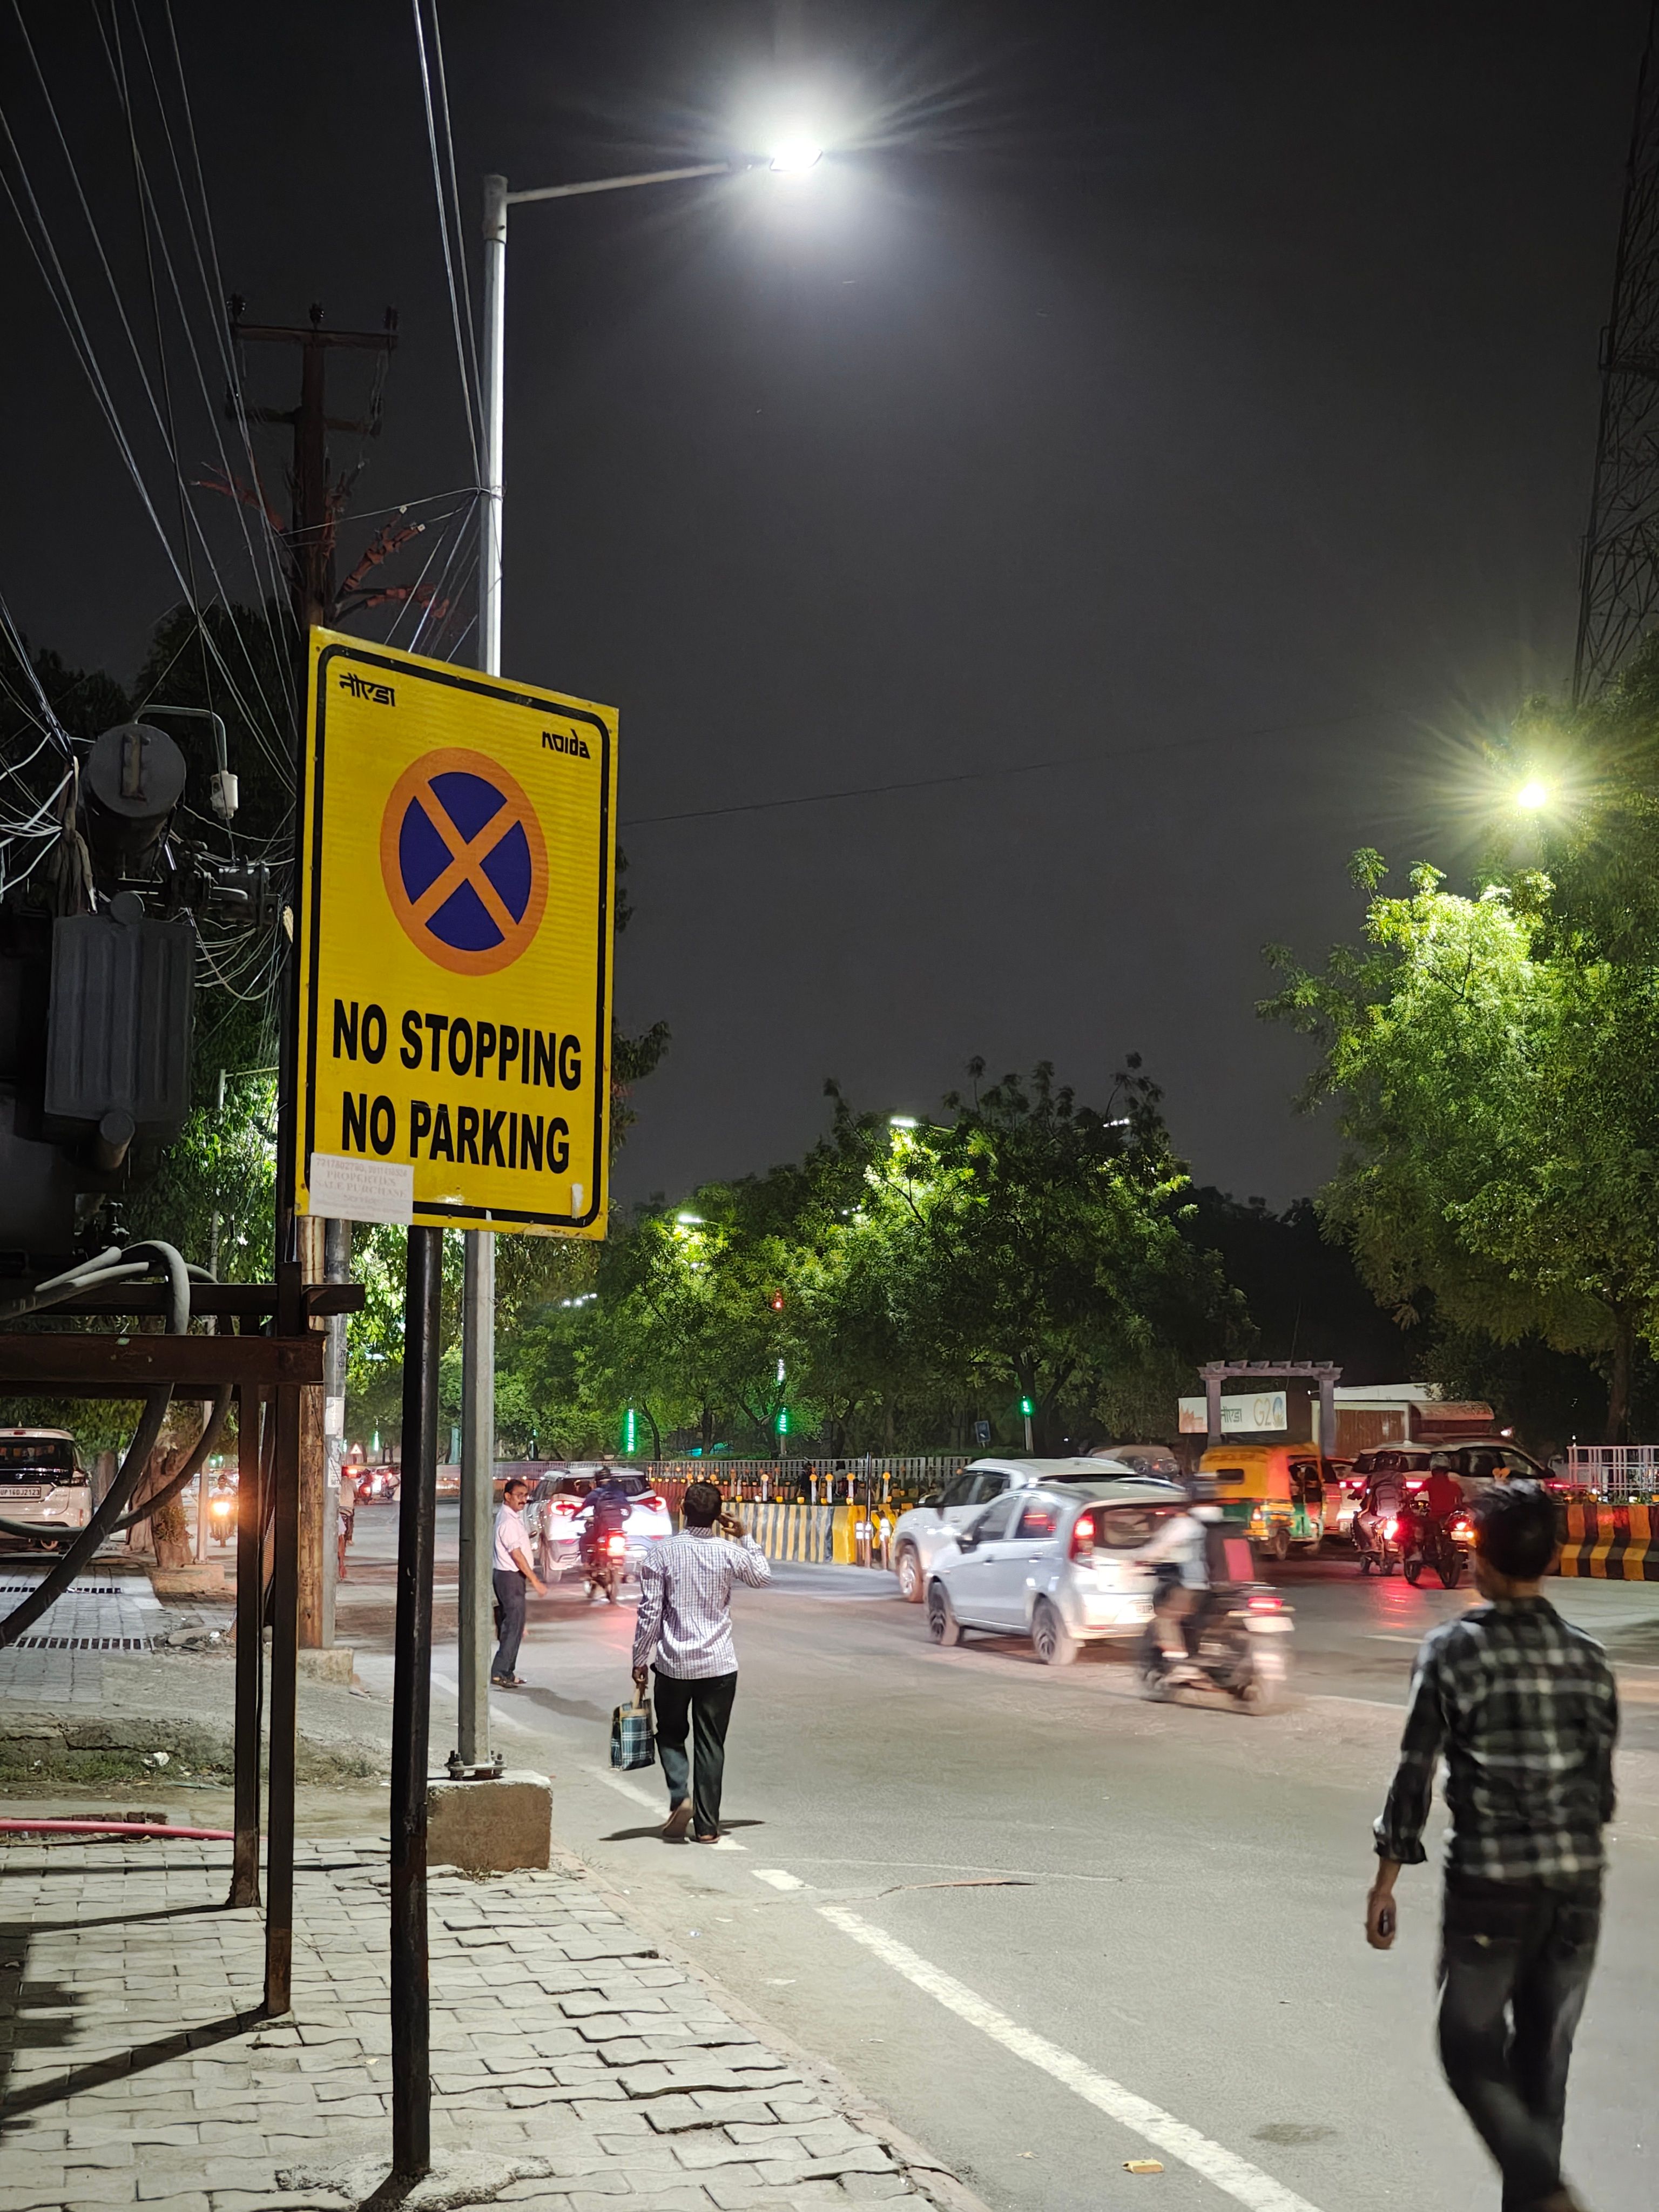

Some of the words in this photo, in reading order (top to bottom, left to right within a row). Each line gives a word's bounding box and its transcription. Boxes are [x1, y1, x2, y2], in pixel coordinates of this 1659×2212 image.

[333, 999, 387, 1064] NO
[400, 1010, 581, 1091] STOPPING
[342, 1091, 395, 1156] NO
[410, 1100, 570, 1174] PARKING
